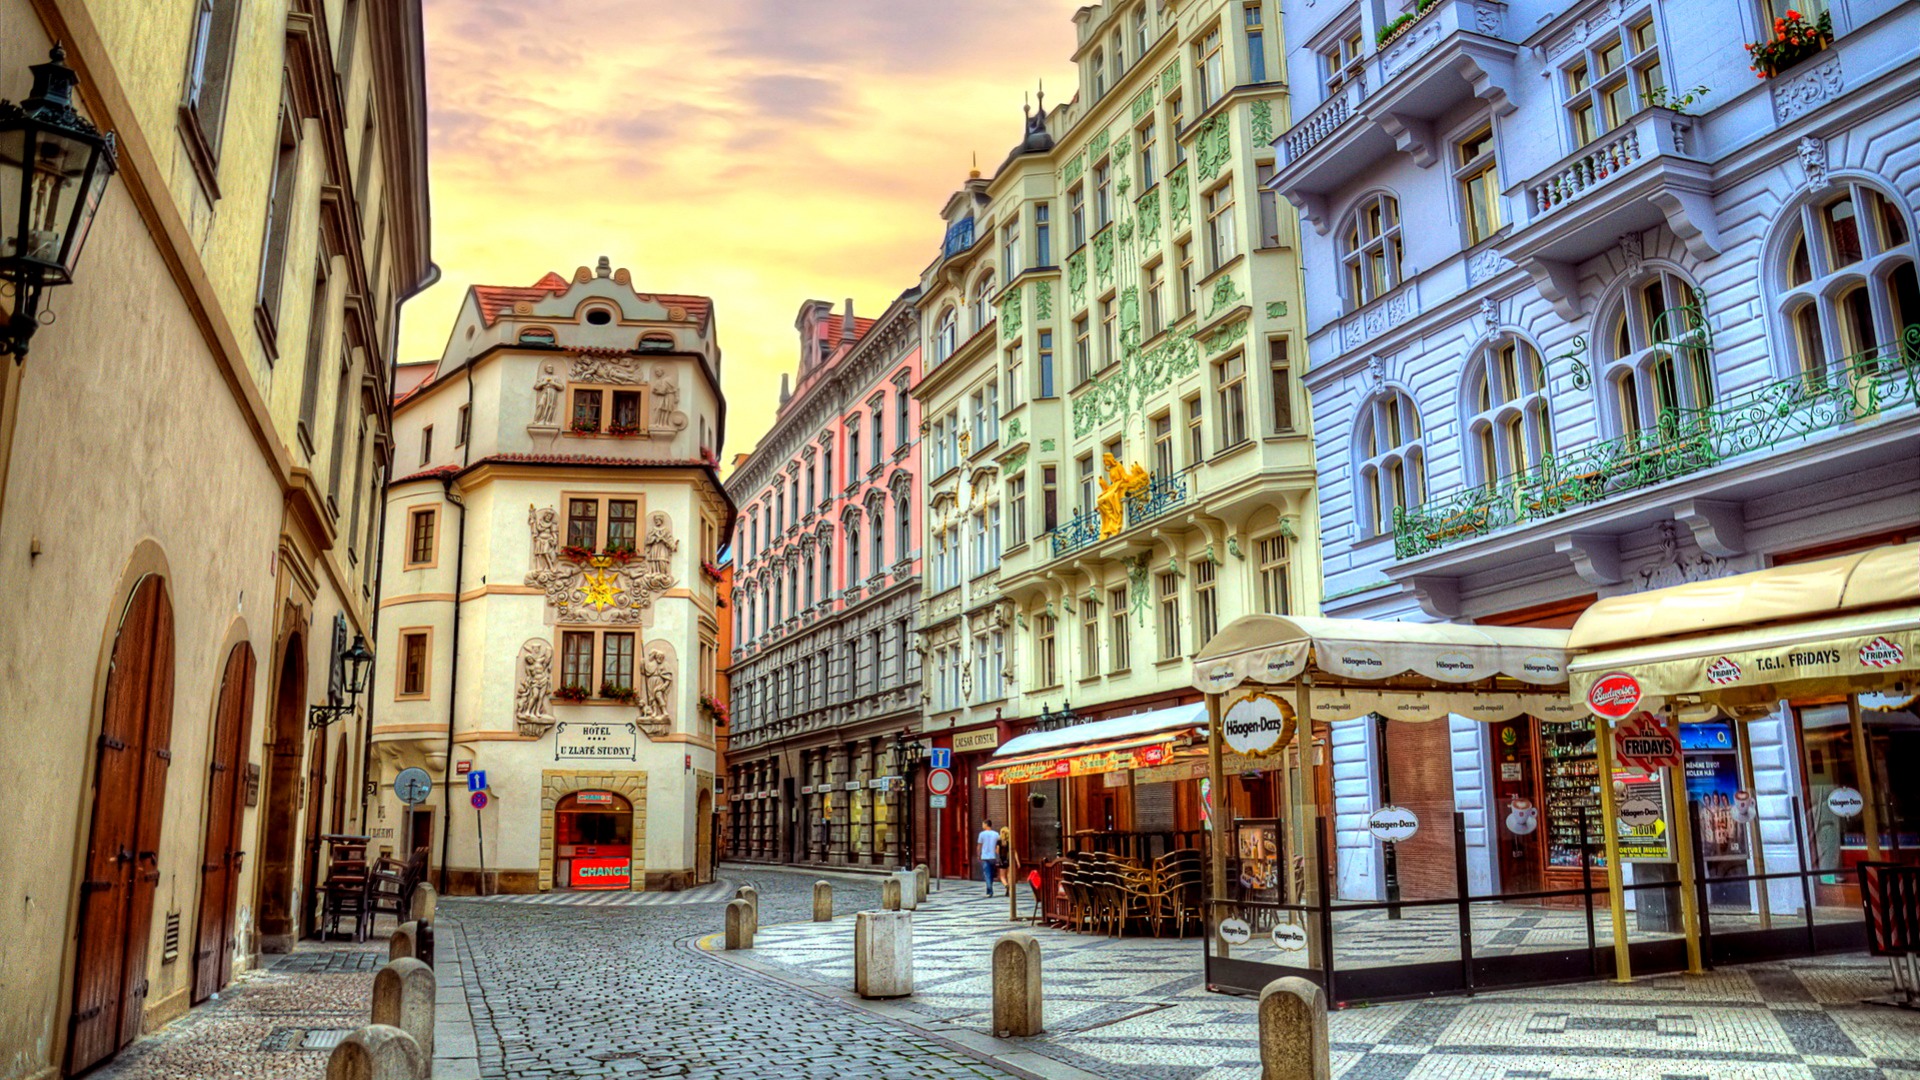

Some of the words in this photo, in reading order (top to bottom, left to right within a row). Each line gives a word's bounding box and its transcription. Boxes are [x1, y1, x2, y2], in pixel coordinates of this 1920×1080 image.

[1756, 656, 1785, 671] T.G.I.
[582, 727, 611, 735] HOTEL
[1226, 716, 1282, 738] Häagen-Dazs
[974, 733, 996, 745] CRYSTAL
[560, 746, 567, 755] U
[568, 745, 595, 755] ZLATÉ
[597, 746, 631, 755] STUDNY
[1370, 819, 1416, 831] Häagen-Dazs
[579, 866, 630, 877] CHANGE
